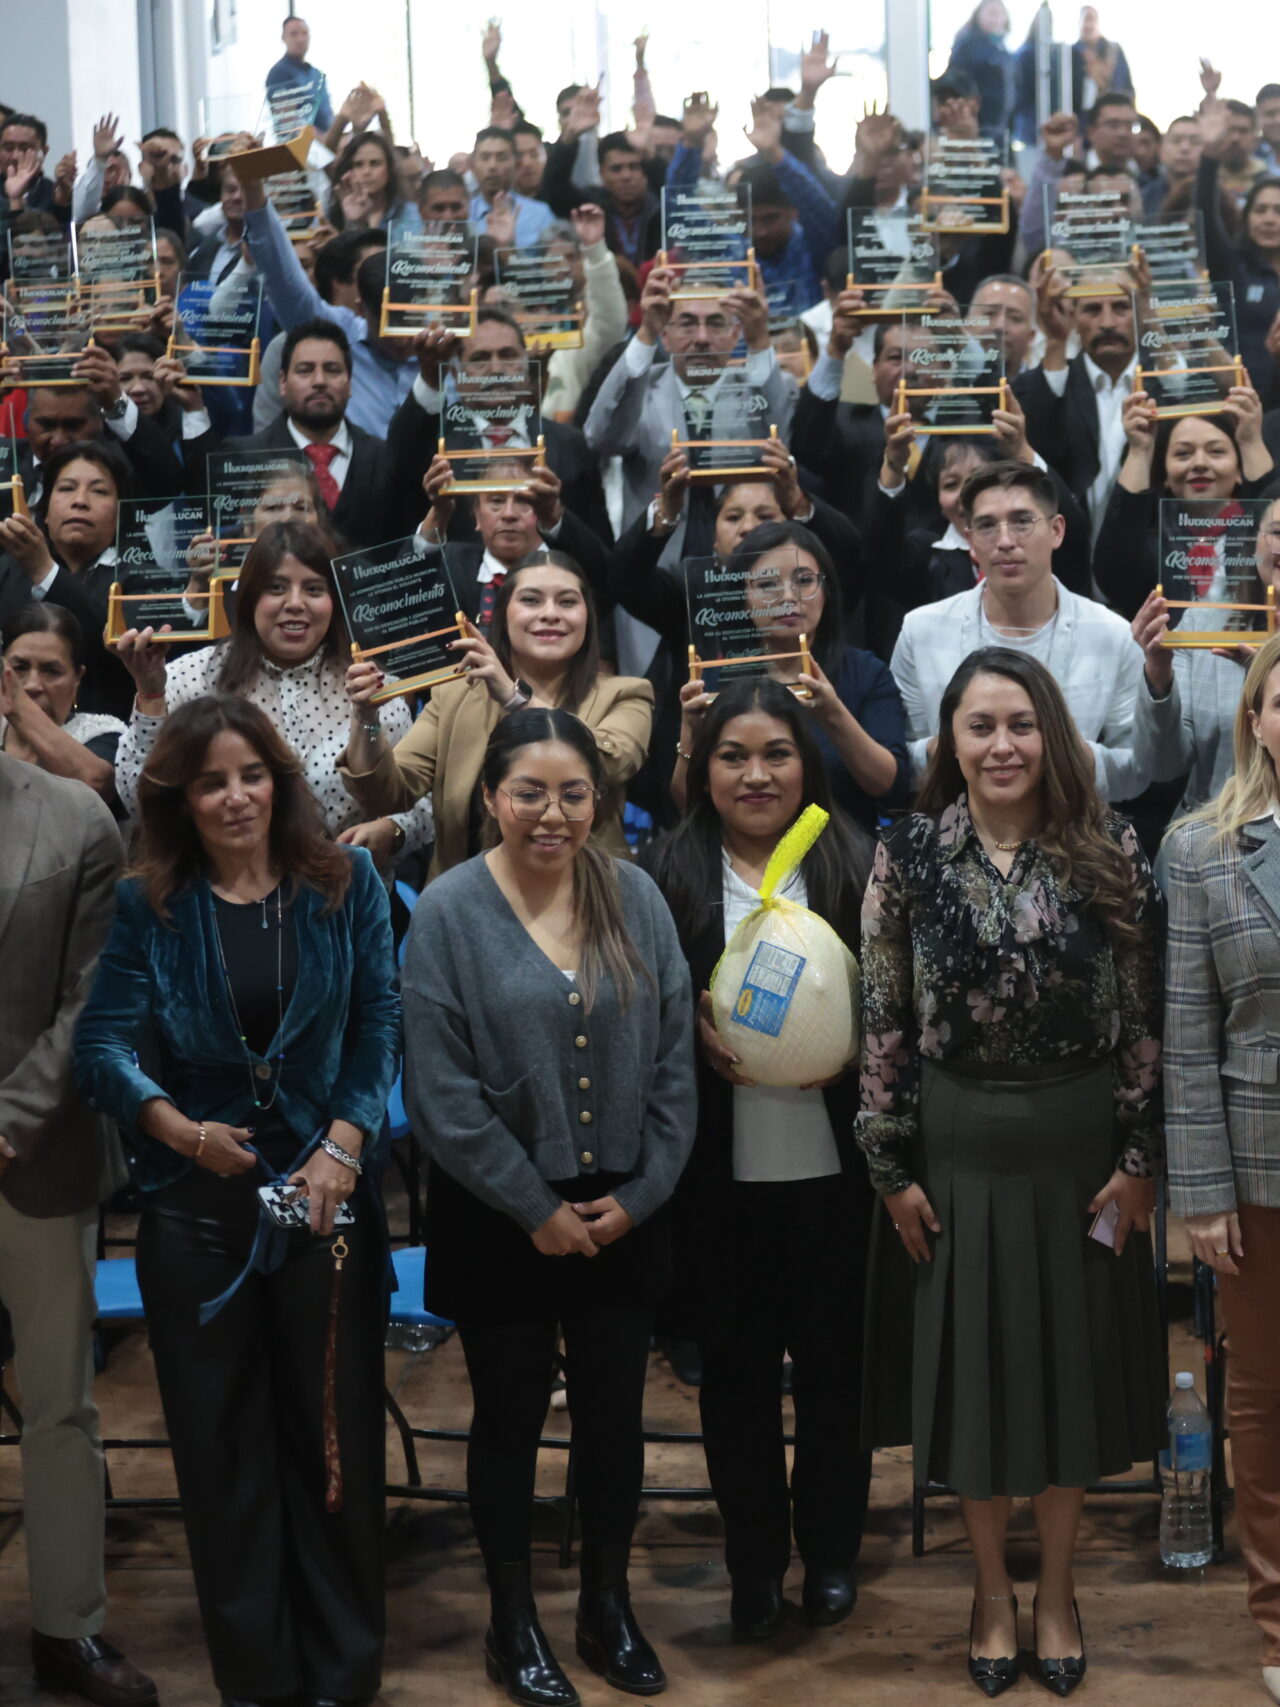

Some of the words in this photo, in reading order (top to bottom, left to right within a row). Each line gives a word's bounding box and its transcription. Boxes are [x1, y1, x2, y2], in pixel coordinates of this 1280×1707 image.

[353, 552, 426, 580] HUIXQUILUCAN
[352, 583, 445, 623] Reconocimiento
[695, 602, 796, 626] Reconocimiento
